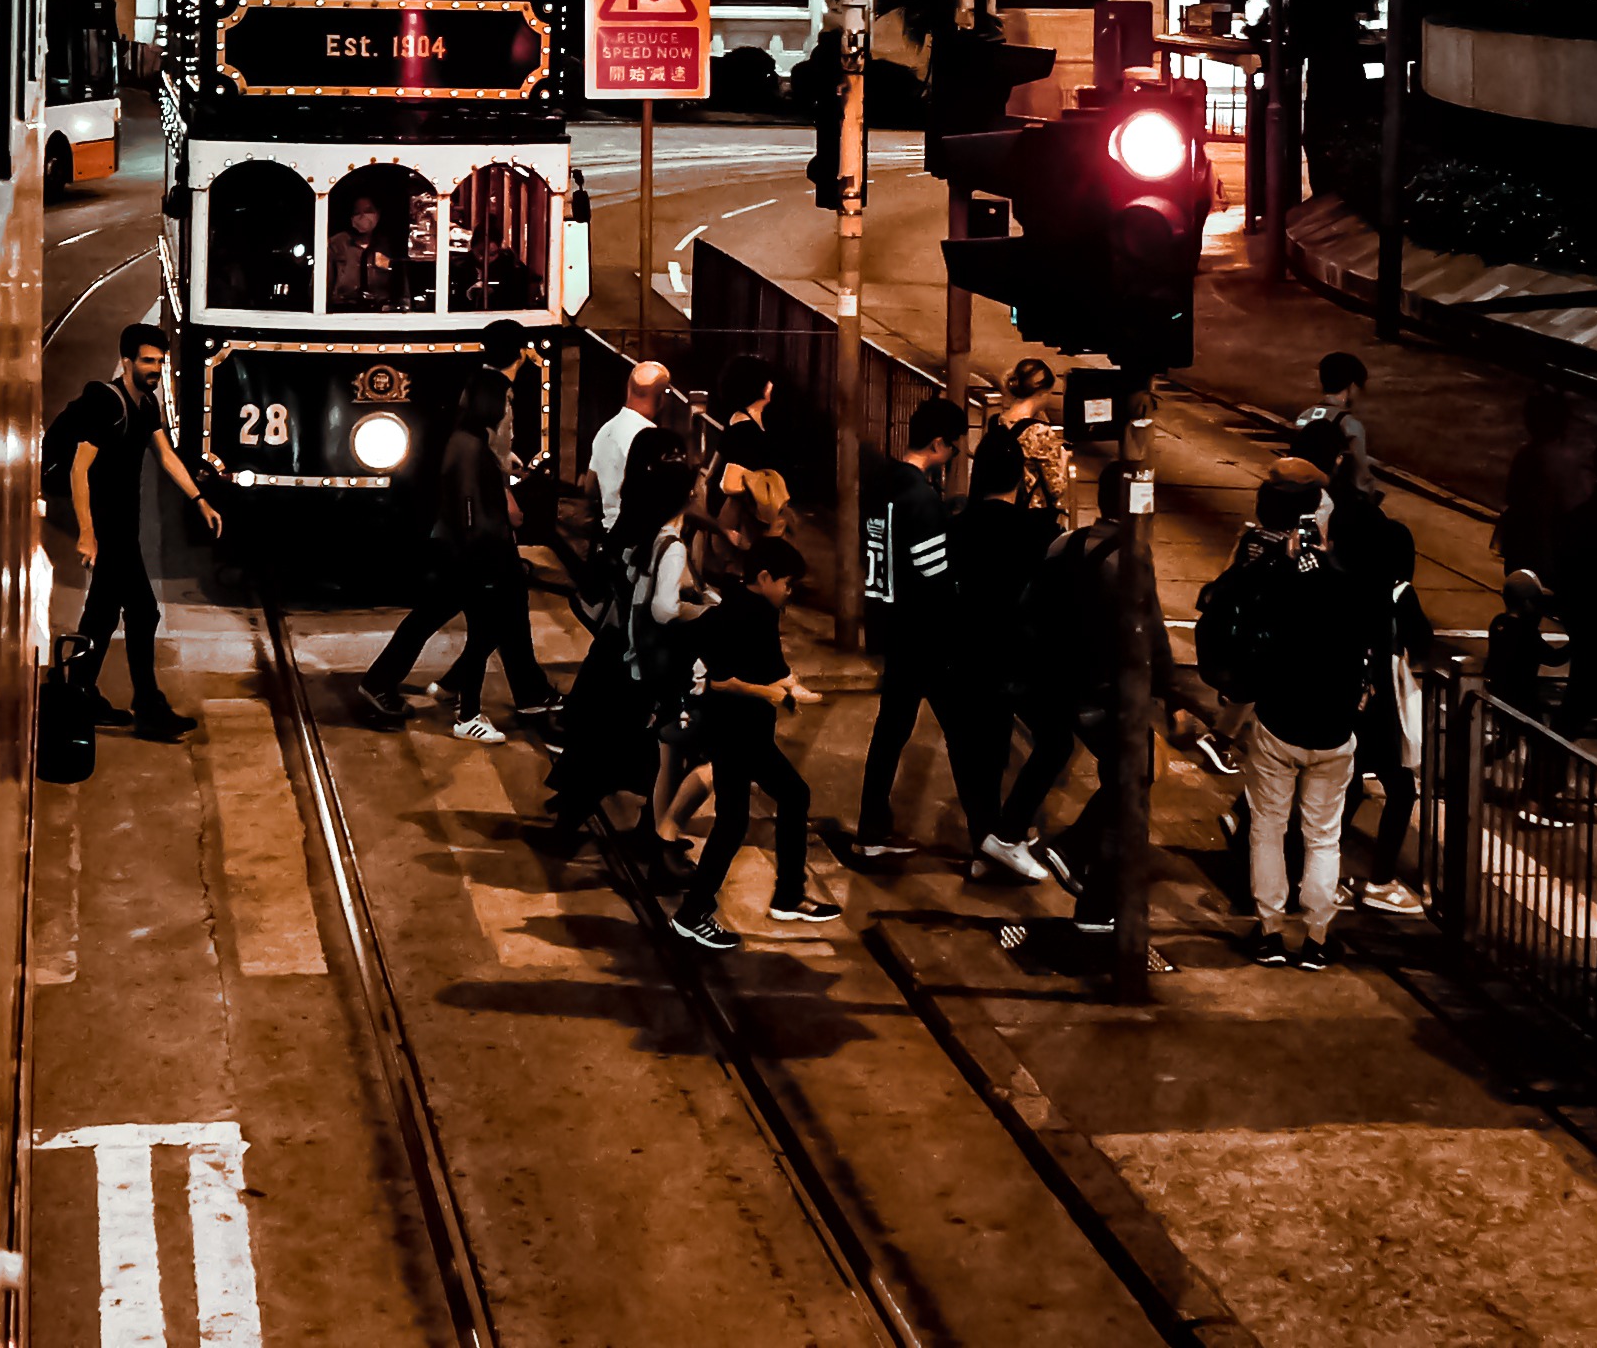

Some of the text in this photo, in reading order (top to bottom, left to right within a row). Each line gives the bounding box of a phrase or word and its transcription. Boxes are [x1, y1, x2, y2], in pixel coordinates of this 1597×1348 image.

[326, 34, 446, 59] Est. 1904
[617, 32, 679, 44] REDUCE
[602, 46, 693, 60] SPEED NOW
[239, 403, 289, 446] 28
